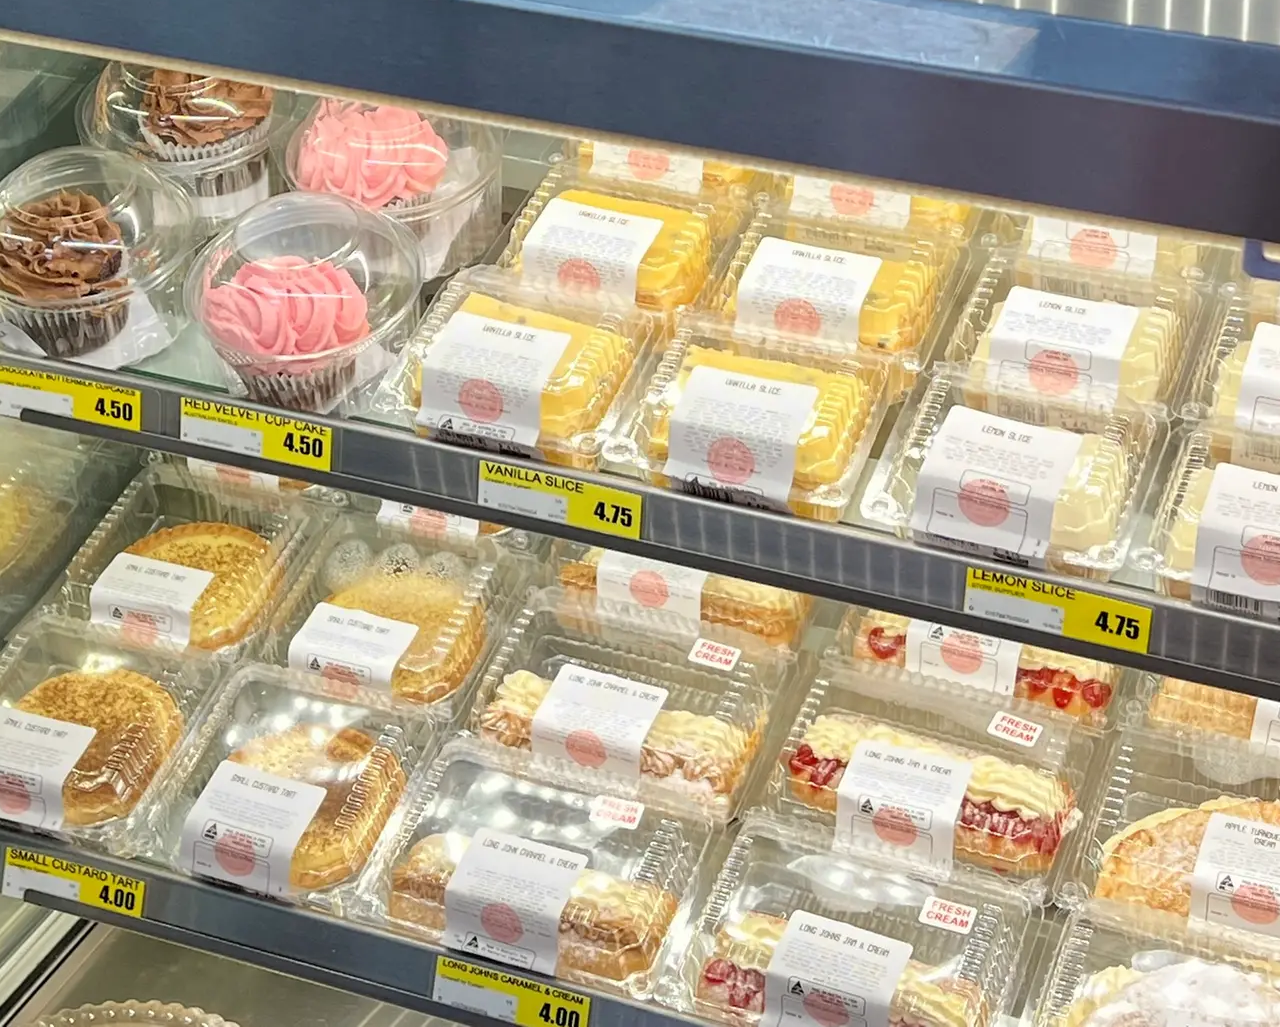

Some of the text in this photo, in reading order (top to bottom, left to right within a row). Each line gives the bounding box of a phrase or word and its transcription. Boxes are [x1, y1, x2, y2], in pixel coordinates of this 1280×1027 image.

[95, 397, 133, 422] 4.50
[184, 398, 327, 436] RED VELVET CUP CAKE
[283, 432, 324, 459] 4.50
[982, 425, 1033, 444] LEMON SLICE
[484, 462, 584, 494] VANILLA SLICE
[1253, 482, 1279, 493] LEMON
[594, 502, 633, 528] 4.75
[973, 569, 1076, 601] LEMON SLICE
[1095, 611, 1140, 640] 4.75
[695, 650, 732, 667] CREAM
[700, 641, 736, 658] FRESH
[995, 724, 1034, 744] CREAM
[1000, 716, 1037, 734] FRESH
[1225, 822, 1248, 834] APPLE
[1254, 838, 1277, 849] CREAM
[10, 849, 49, 867] SMALL
[52, 859, 108, 882] CUSTARD
[111, 873, 140, 891] TART
[99, 885, 135, 911] 4.00
[931, 900, 972, 919] FRESH
[926, 909, 969, 930] CREAM
[799, 923, 818, 935] LONG
[820, 929, 841, 943] JOHNS
[843, 936, 858, 948] JAM
[868, 944, 890, 958] CREAM
[442, 959, 584, 1006] LONG JOHNS CARAMEL & CREAM
[539, 1002, 579, 1027] 4.00
